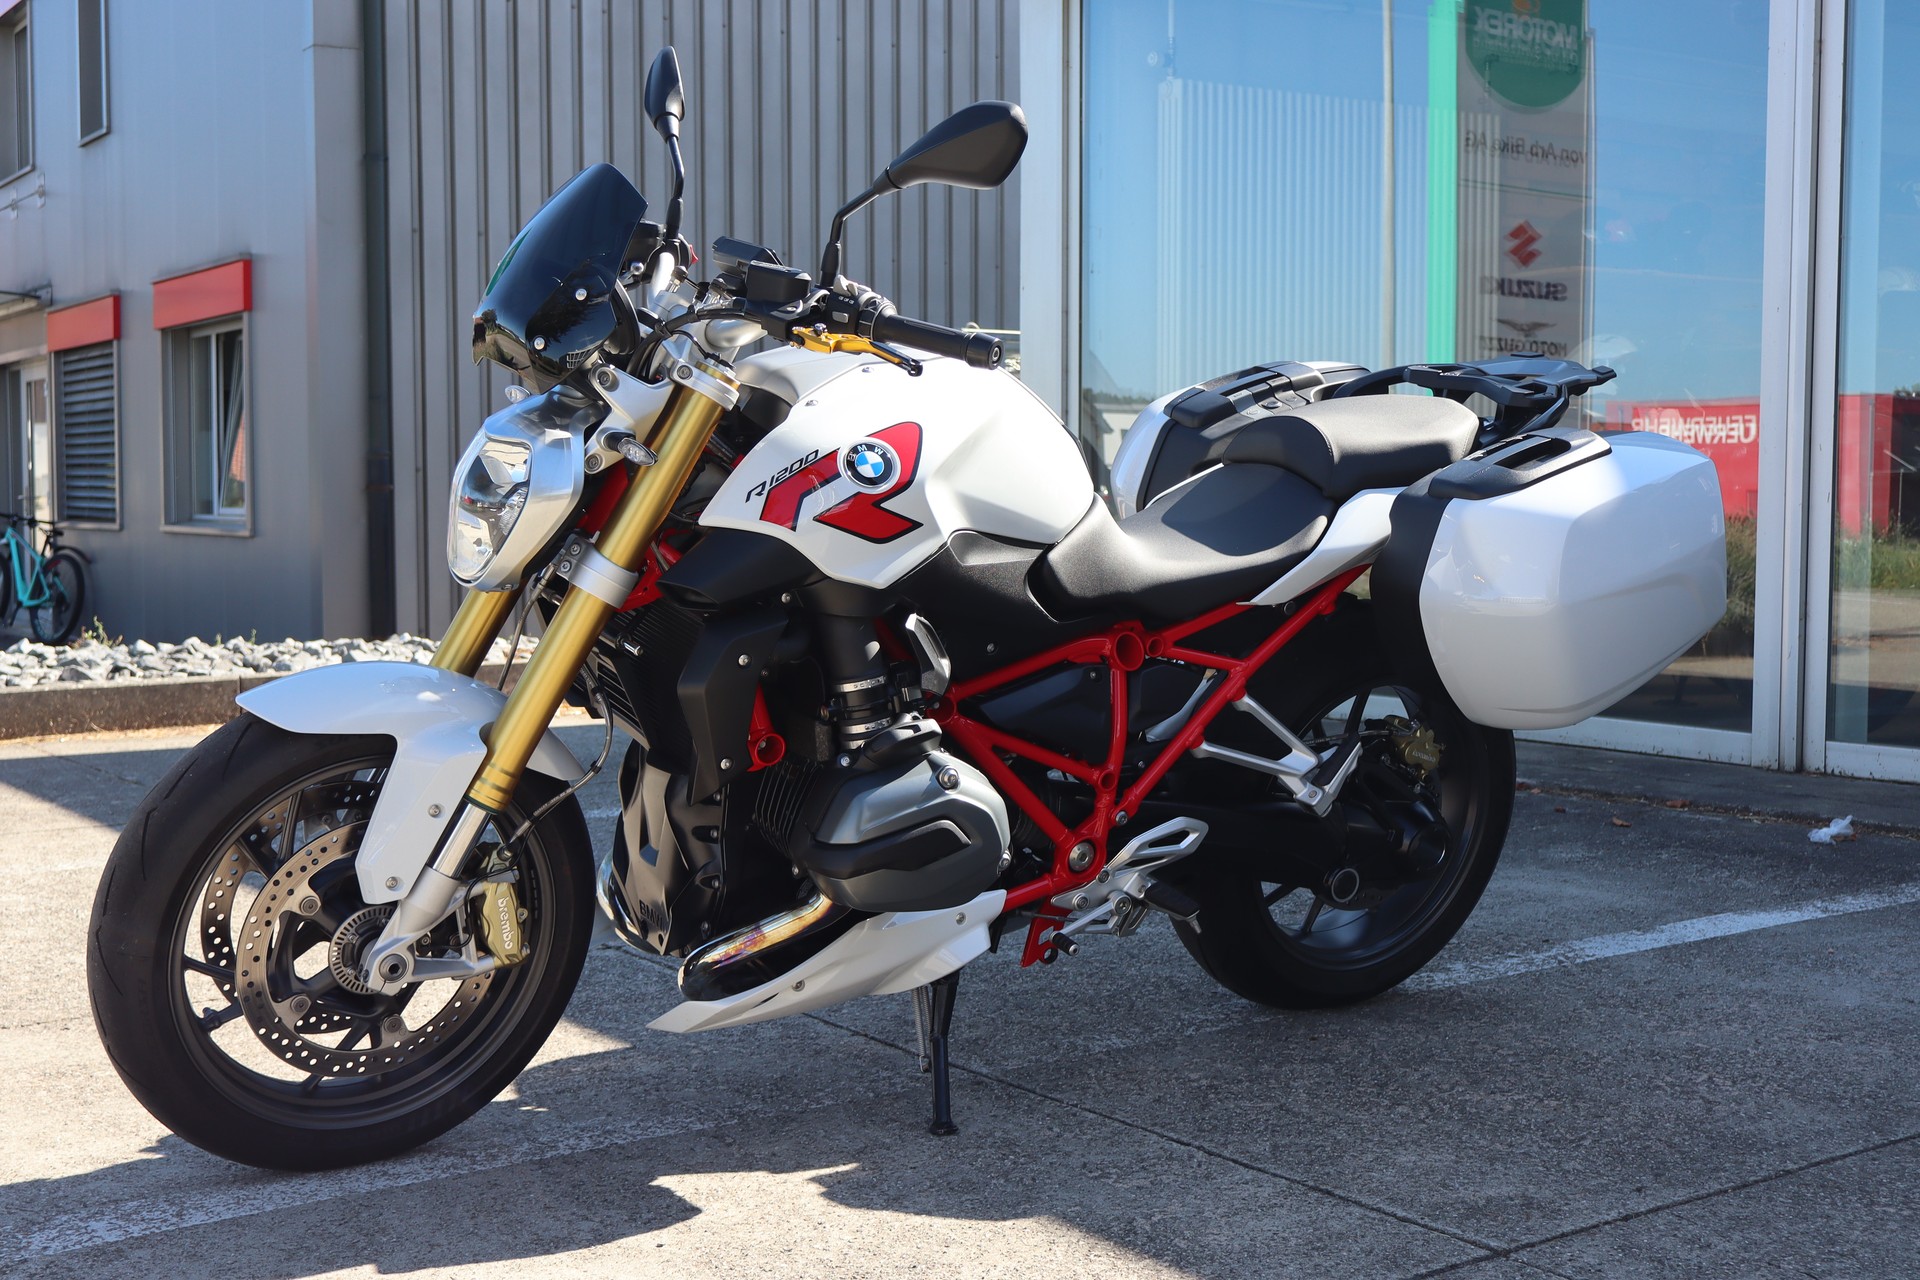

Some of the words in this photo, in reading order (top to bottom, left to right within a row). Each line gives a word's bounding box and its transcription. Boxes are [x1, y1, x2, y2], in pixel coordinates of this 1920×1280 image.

[848, 444, 885, 462] BMW
[497, 896, 513, 950] brembo
[638, 899, 664, 931] BMW
